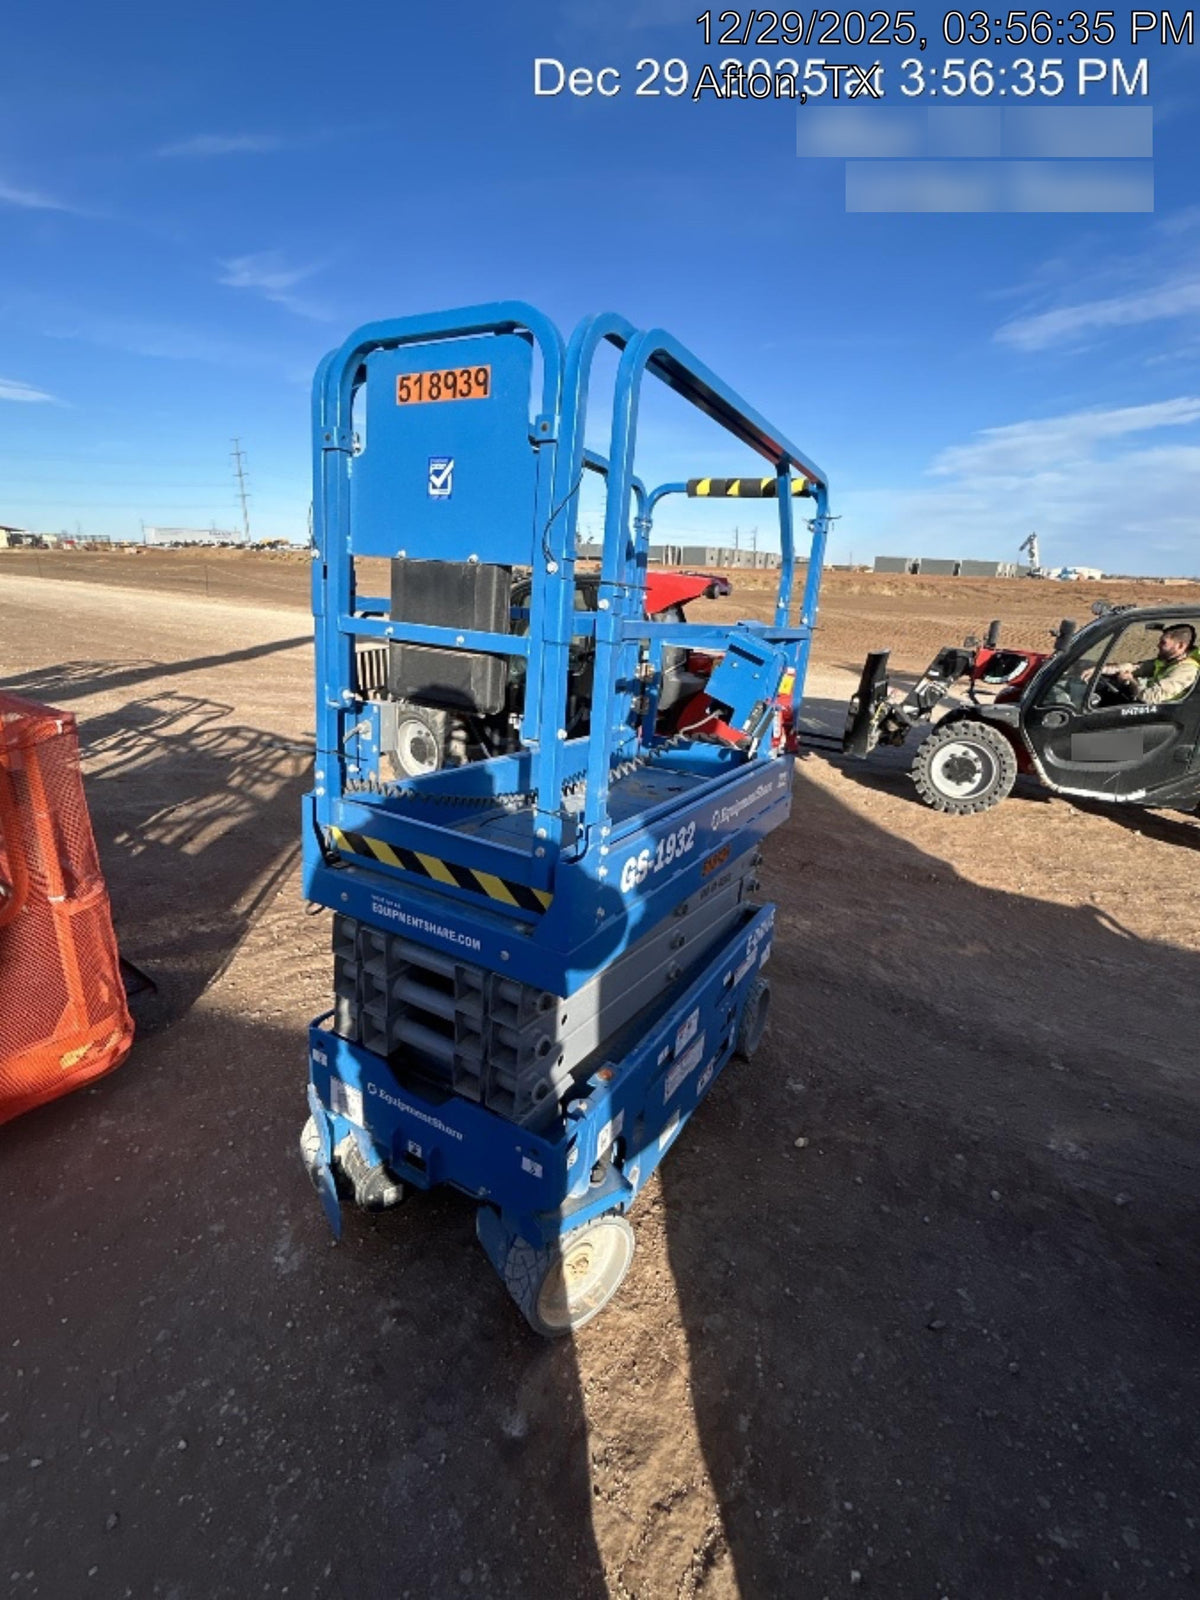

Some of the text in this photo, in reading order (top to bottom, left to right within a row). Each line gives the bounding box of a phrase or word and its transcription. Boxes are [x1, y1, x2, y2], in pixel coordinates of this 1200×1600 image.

[398, 367, 489, 402] 518939
[620, 821, 696, 893] GS-1932
[372, 902, 481, 951] EQUIPMENTSHARE.COM
[378, 1088, 463, 1141] EquipmentShare
